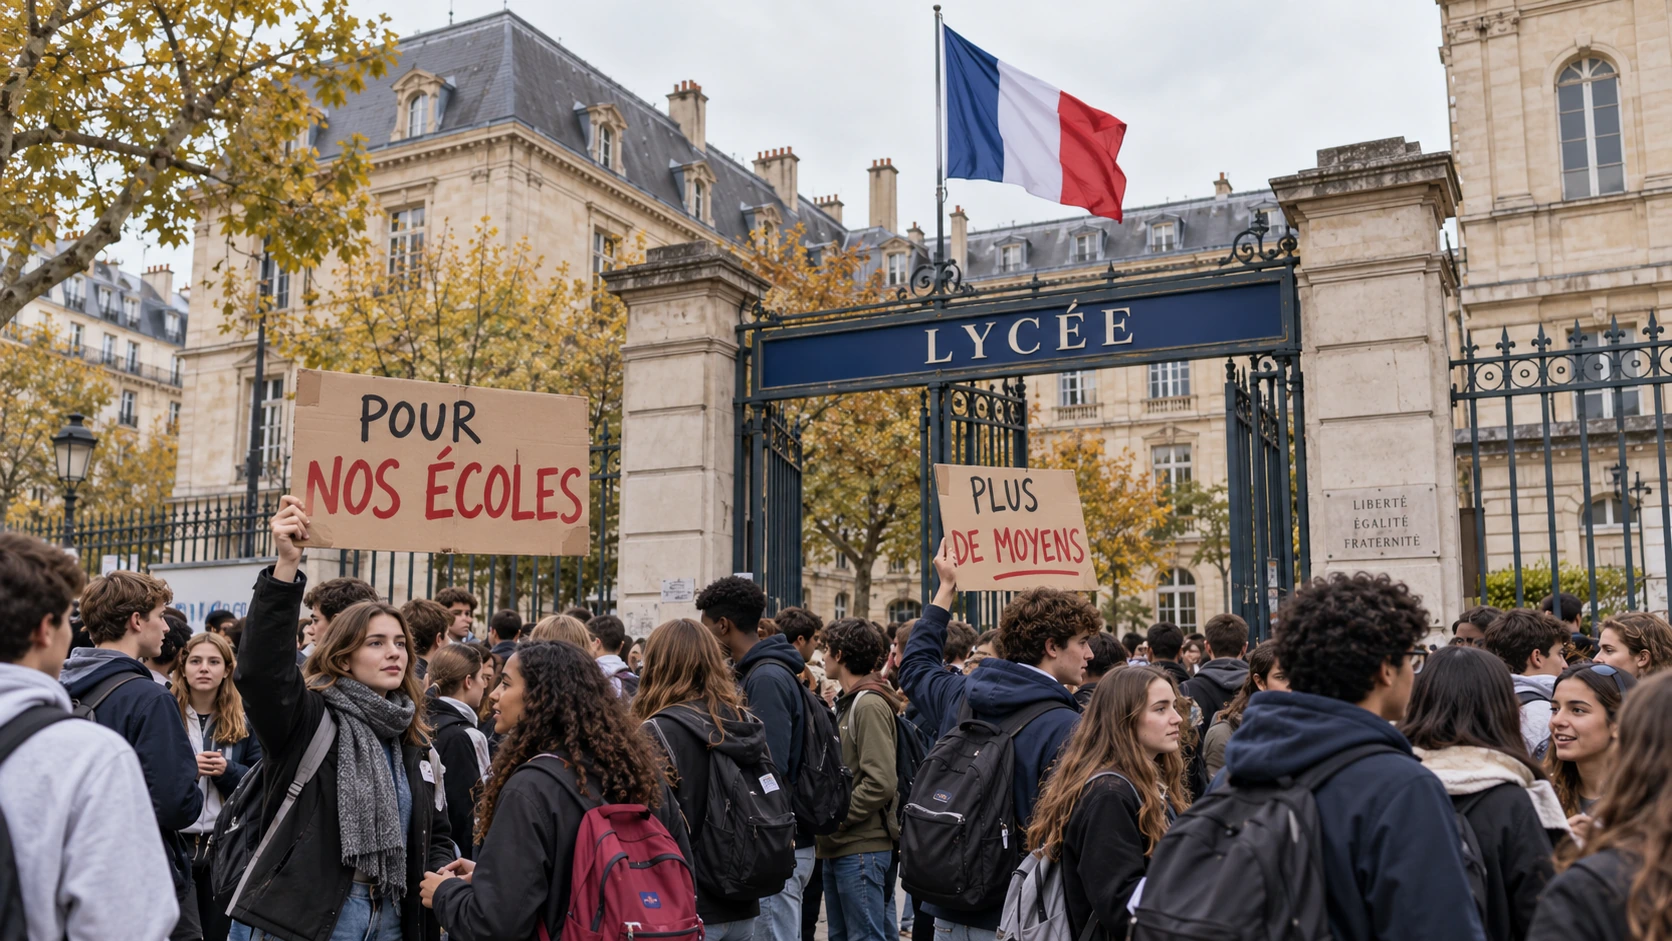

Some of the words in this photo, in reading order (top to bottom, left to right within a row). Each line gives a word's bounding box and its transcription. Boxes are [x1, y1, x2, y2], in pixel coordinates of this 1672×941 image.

[924, 299, 1133, 364] LYCÉE
[360, 394, 482, 444] POUR
[305, 455, 401, 519] NOS
[425, 445, 583, 524] ÉCOLES
[970, 475, 1038, 514] PLUS
[1353, 495, 1407, 510] LIBERTÉ
[1344, 534, 1420, 549] FRATERNITÉ
[1354, 515, 1408, 529] ÉGALITÉ
[951, 529, 984, 566] DE
[993, 527, 1084, 565] MOYENS
